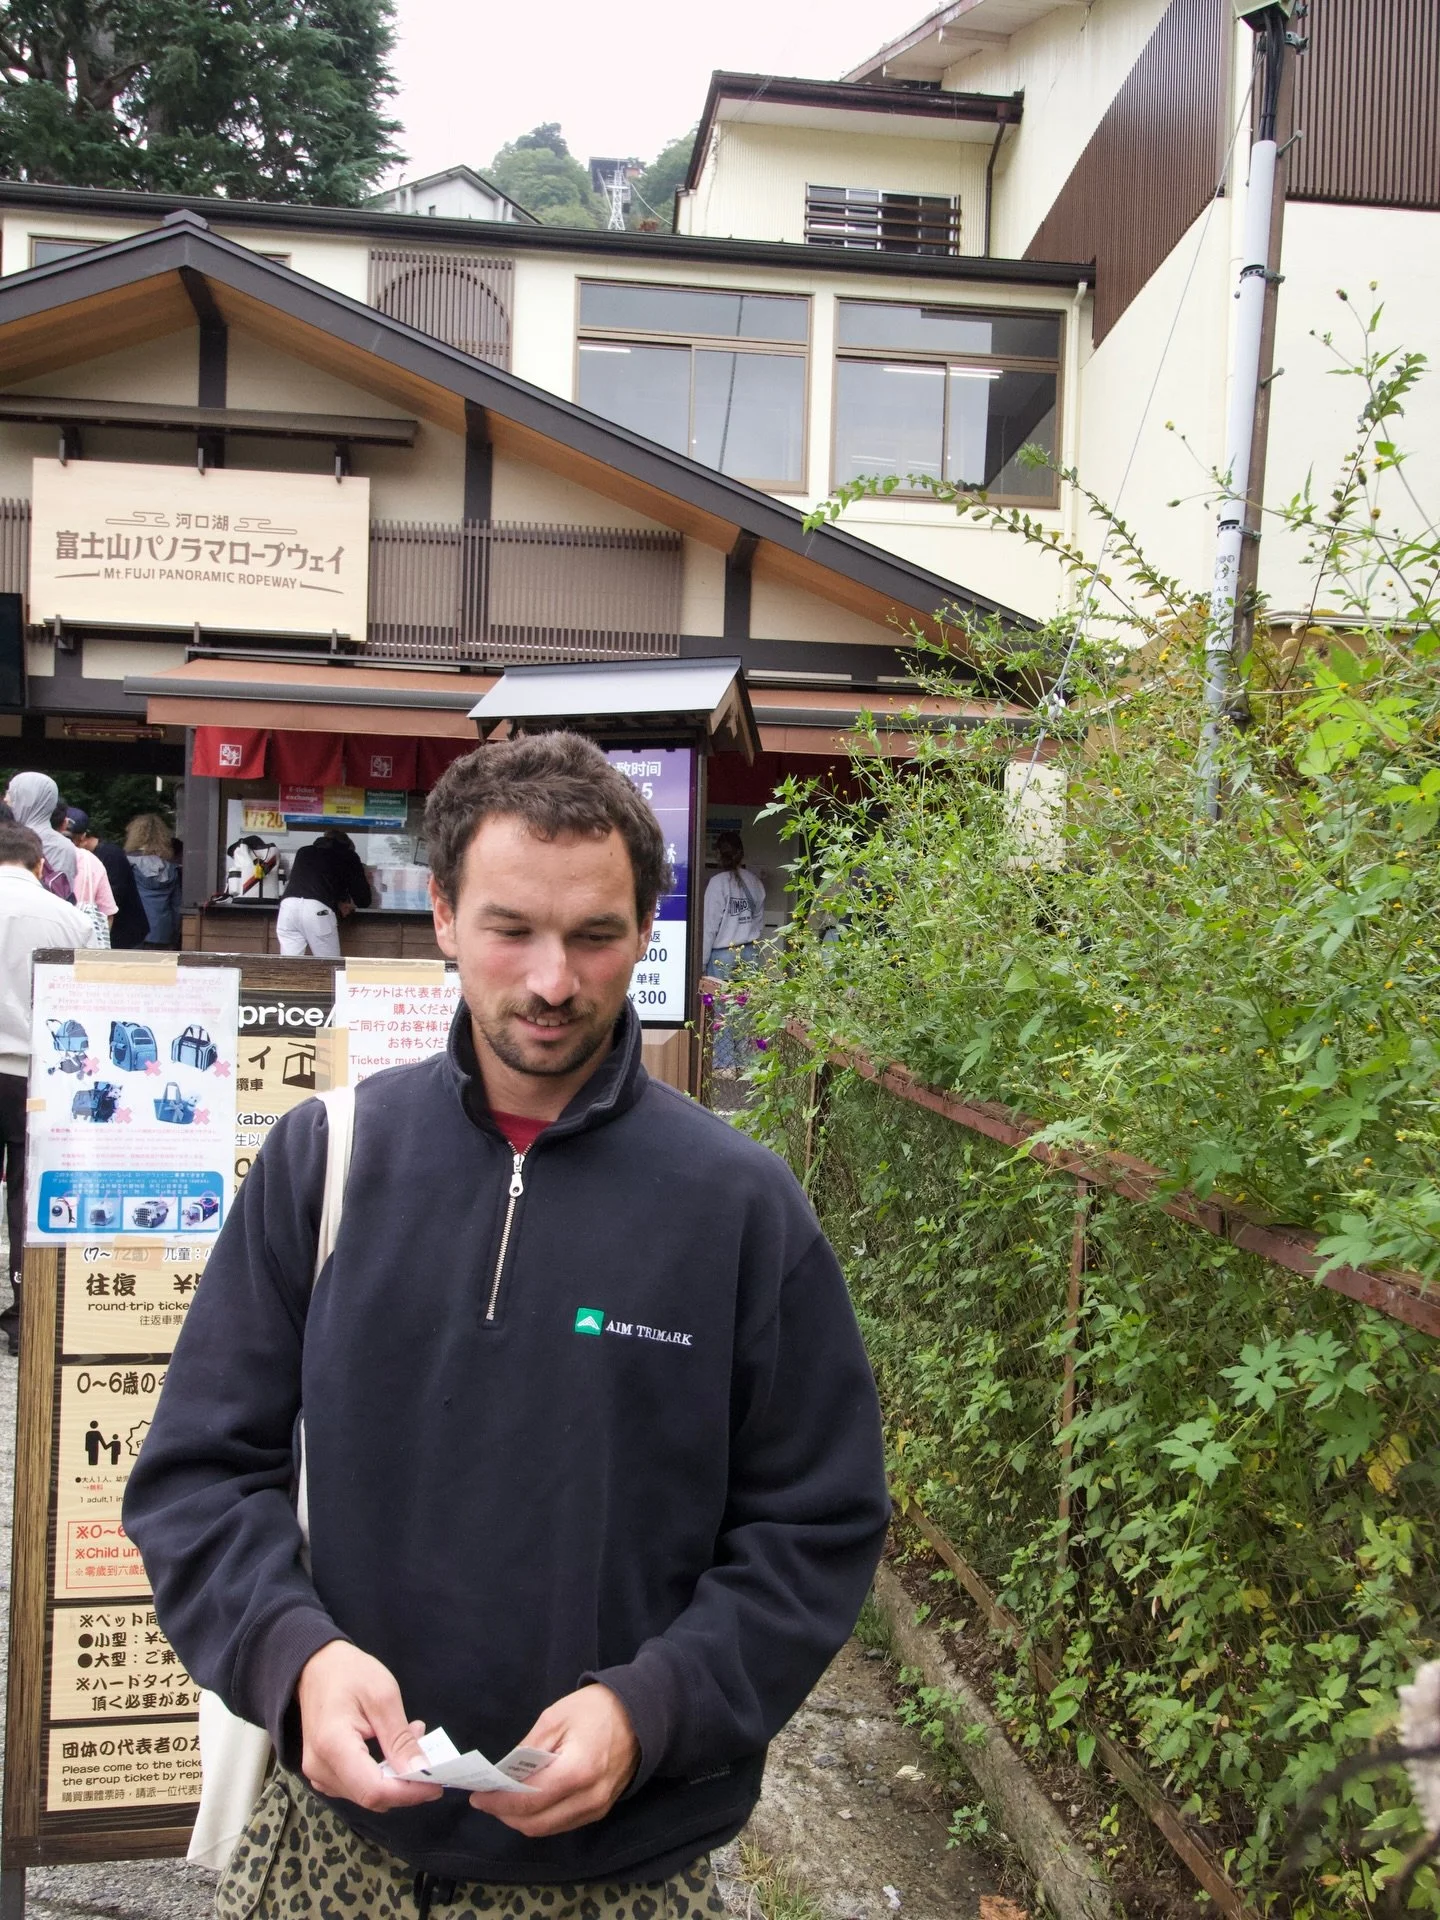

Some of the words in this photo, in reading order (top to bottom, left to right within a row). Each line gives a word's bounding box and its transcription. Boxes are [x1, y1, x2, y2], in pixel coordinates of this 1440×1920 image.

[176, 512, 229, 531] 河口湖
[56, 530, 345, 575] 富士山パノラマロープウェイ
[159, 568, 235, 584] PANORAMIC
[238, 573, 298, 589] ROPEWAY
[636, 973, 661, 985] 单程
[350, 1054, 391, 1065] Tickets
[86, 1273, 137, 1297] 往復
[87, 1301, 155, 1312] round-trip
[605, 1320, 634, 1336] AIM
[636, 1324, 693, 1346] TRIMARK
[62, 1765, 100, 1775] Please
[103, 1763, 132, 1772] come
[136, 1761, 149, 1770] to
[152, 1759, 172, 1769] the
[62, 1776, 82, 1786] the
[85, 1774, 120, 1786] group
[124, 1772, 160, 1782] ticket
[162, 1771, 176, 1781] by
